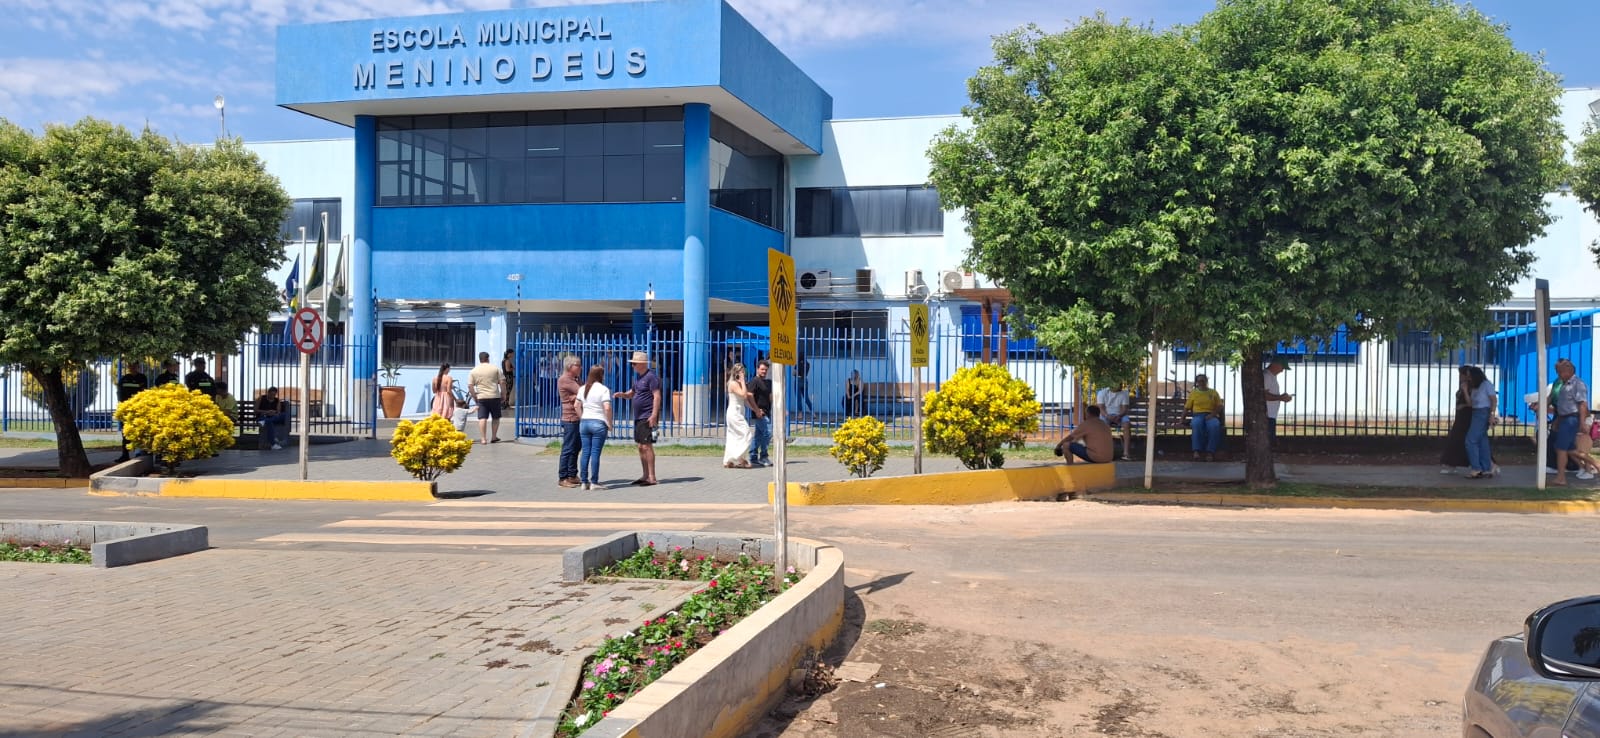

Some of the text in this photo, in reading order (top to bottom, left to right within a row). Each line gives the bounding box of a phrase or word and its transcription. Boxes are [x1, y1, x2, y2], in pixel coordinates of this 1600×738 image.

[371, 17, 612, 51] ESCOLA MUNICIPAL
[353, 48, 647, 89] MENINO DEUS
